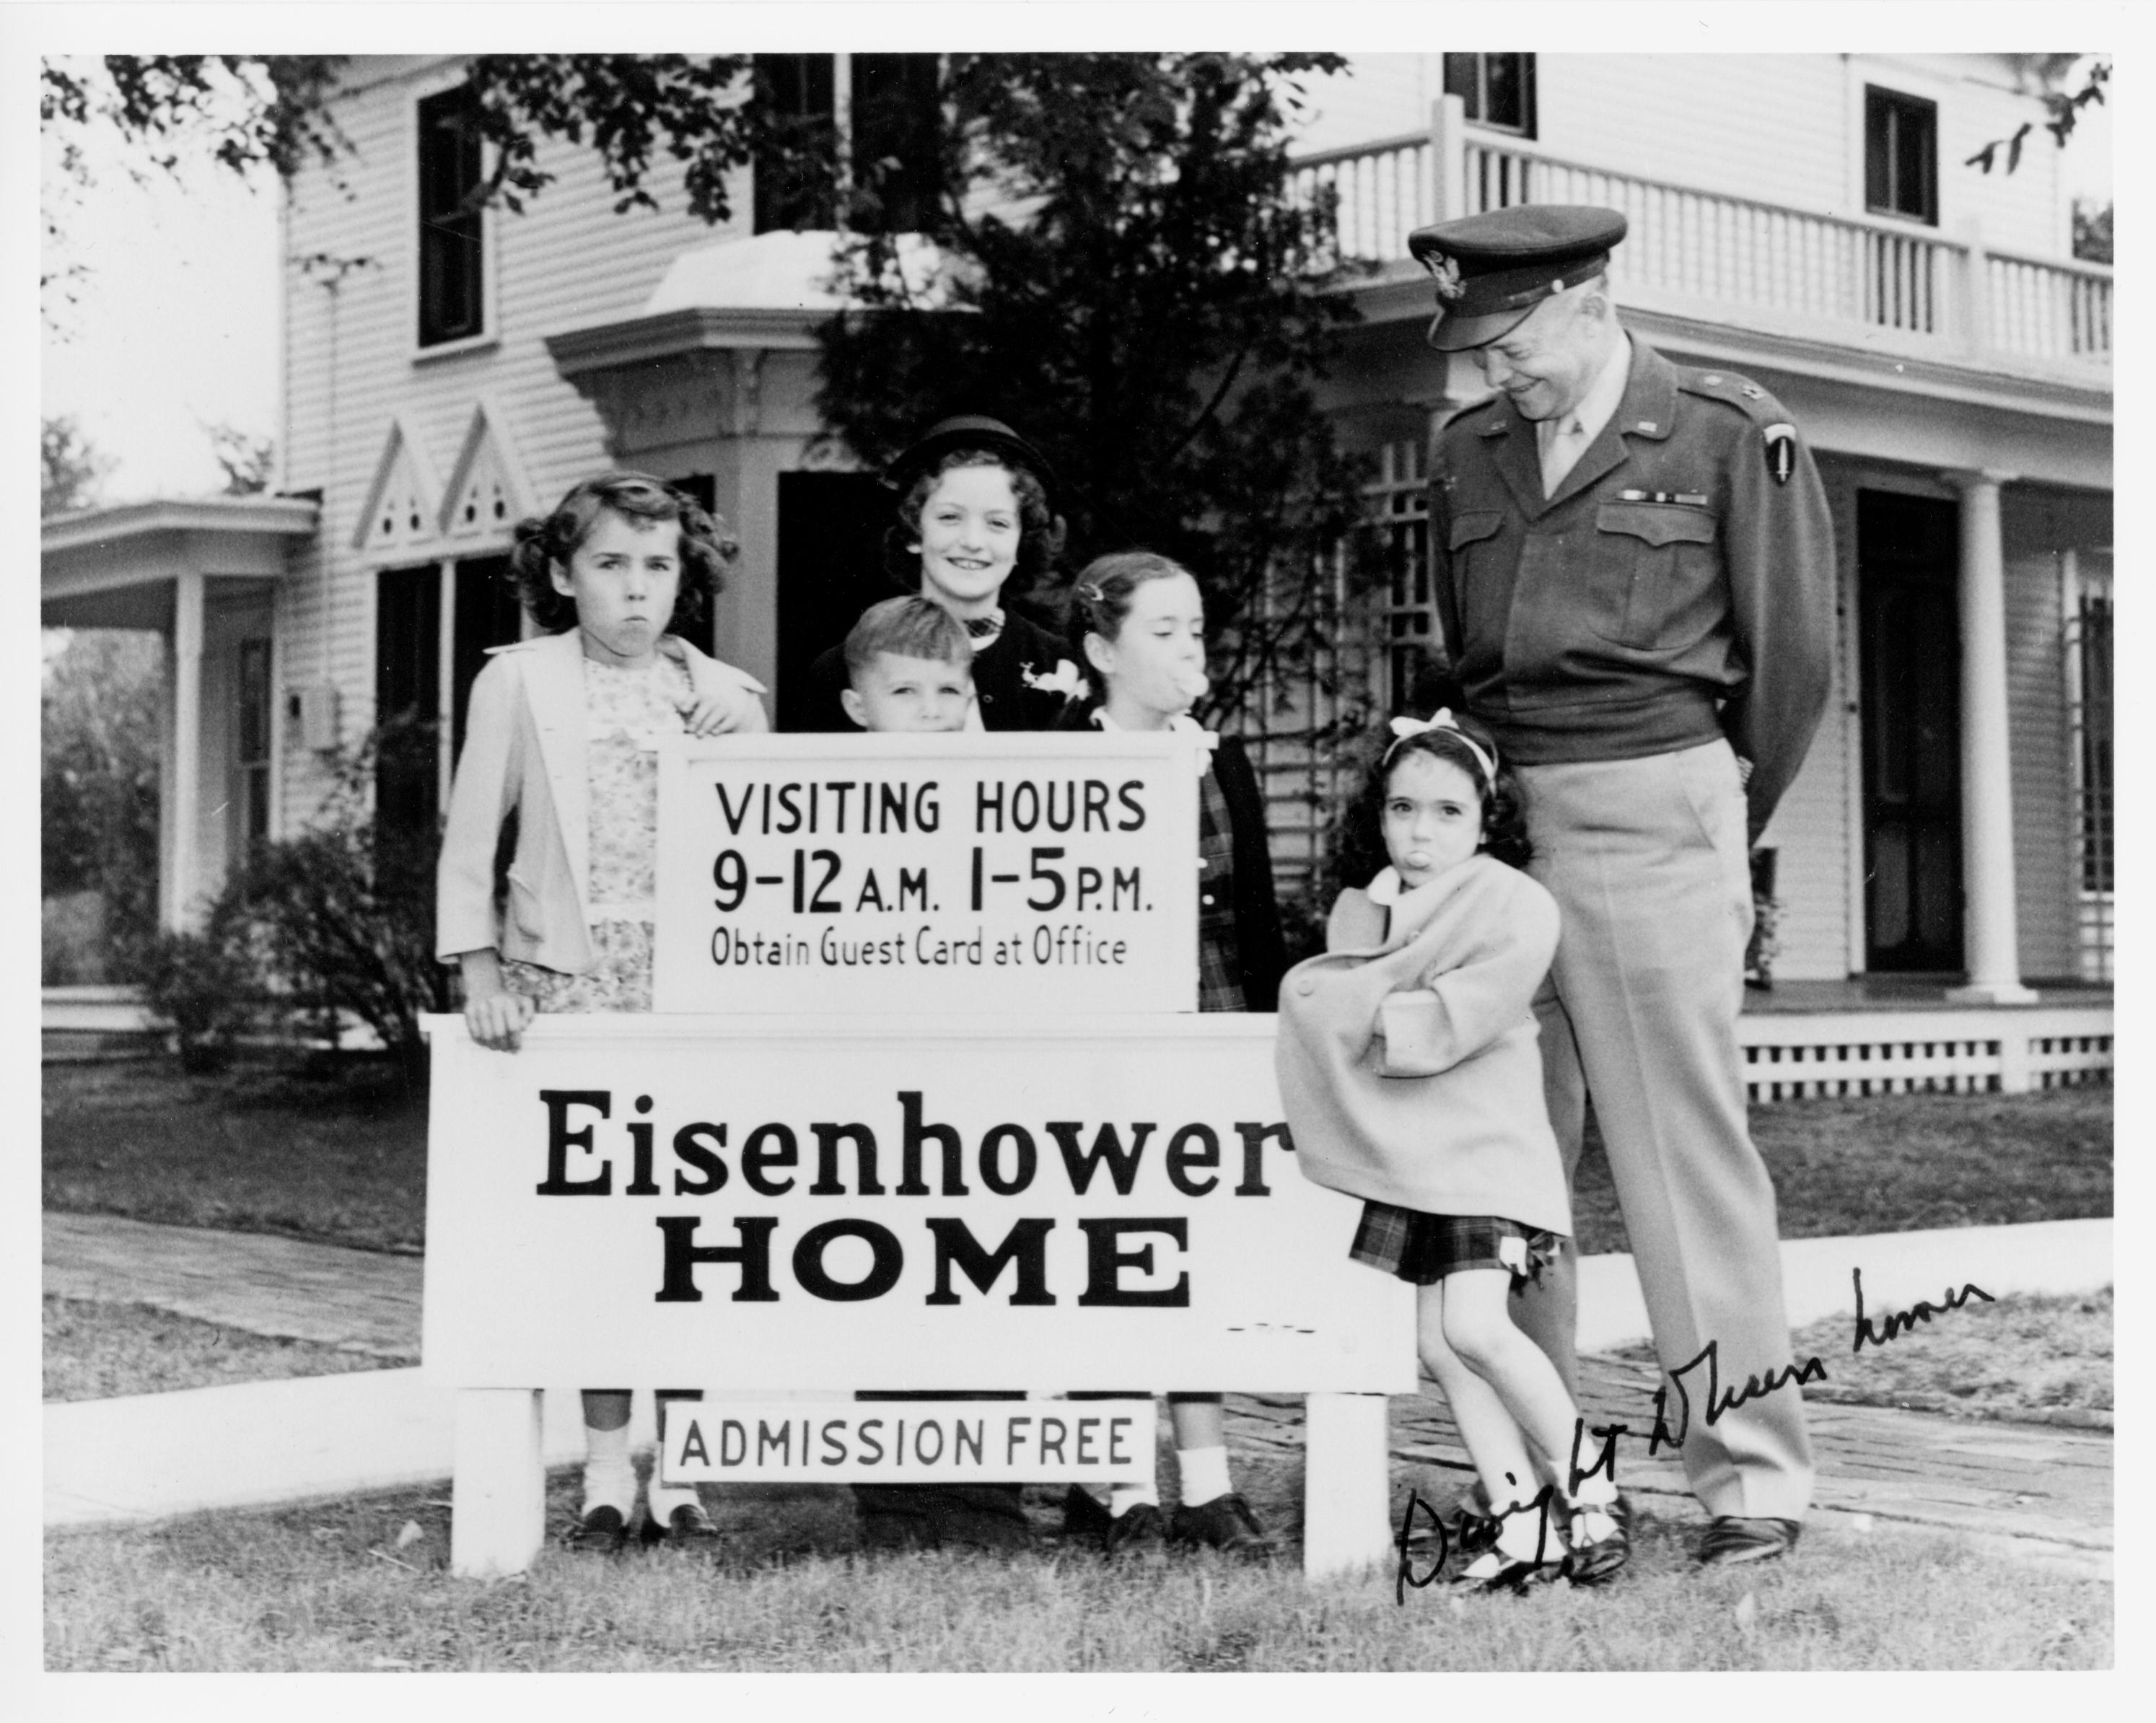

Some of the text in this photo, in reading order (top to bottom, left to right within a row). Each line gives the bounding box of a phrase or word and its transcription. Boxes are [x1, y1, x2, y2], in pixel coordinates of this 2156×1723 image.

[714, 779, 1147, 836] VISITING HOURS
[712, 846, 1153, 914] 9-12 A.M. 1-5 P.M.
[711, 924, 1127, 967] Obtain Guest Card at Office
[535, 1088, 1296, 1198] Eisenhower
[654, 1215, 1191, 1308] HOME
[679, 1416, 1133, 1468] ADMISSION FREE
[1396, 1417, 1629, 1606] Dwight
